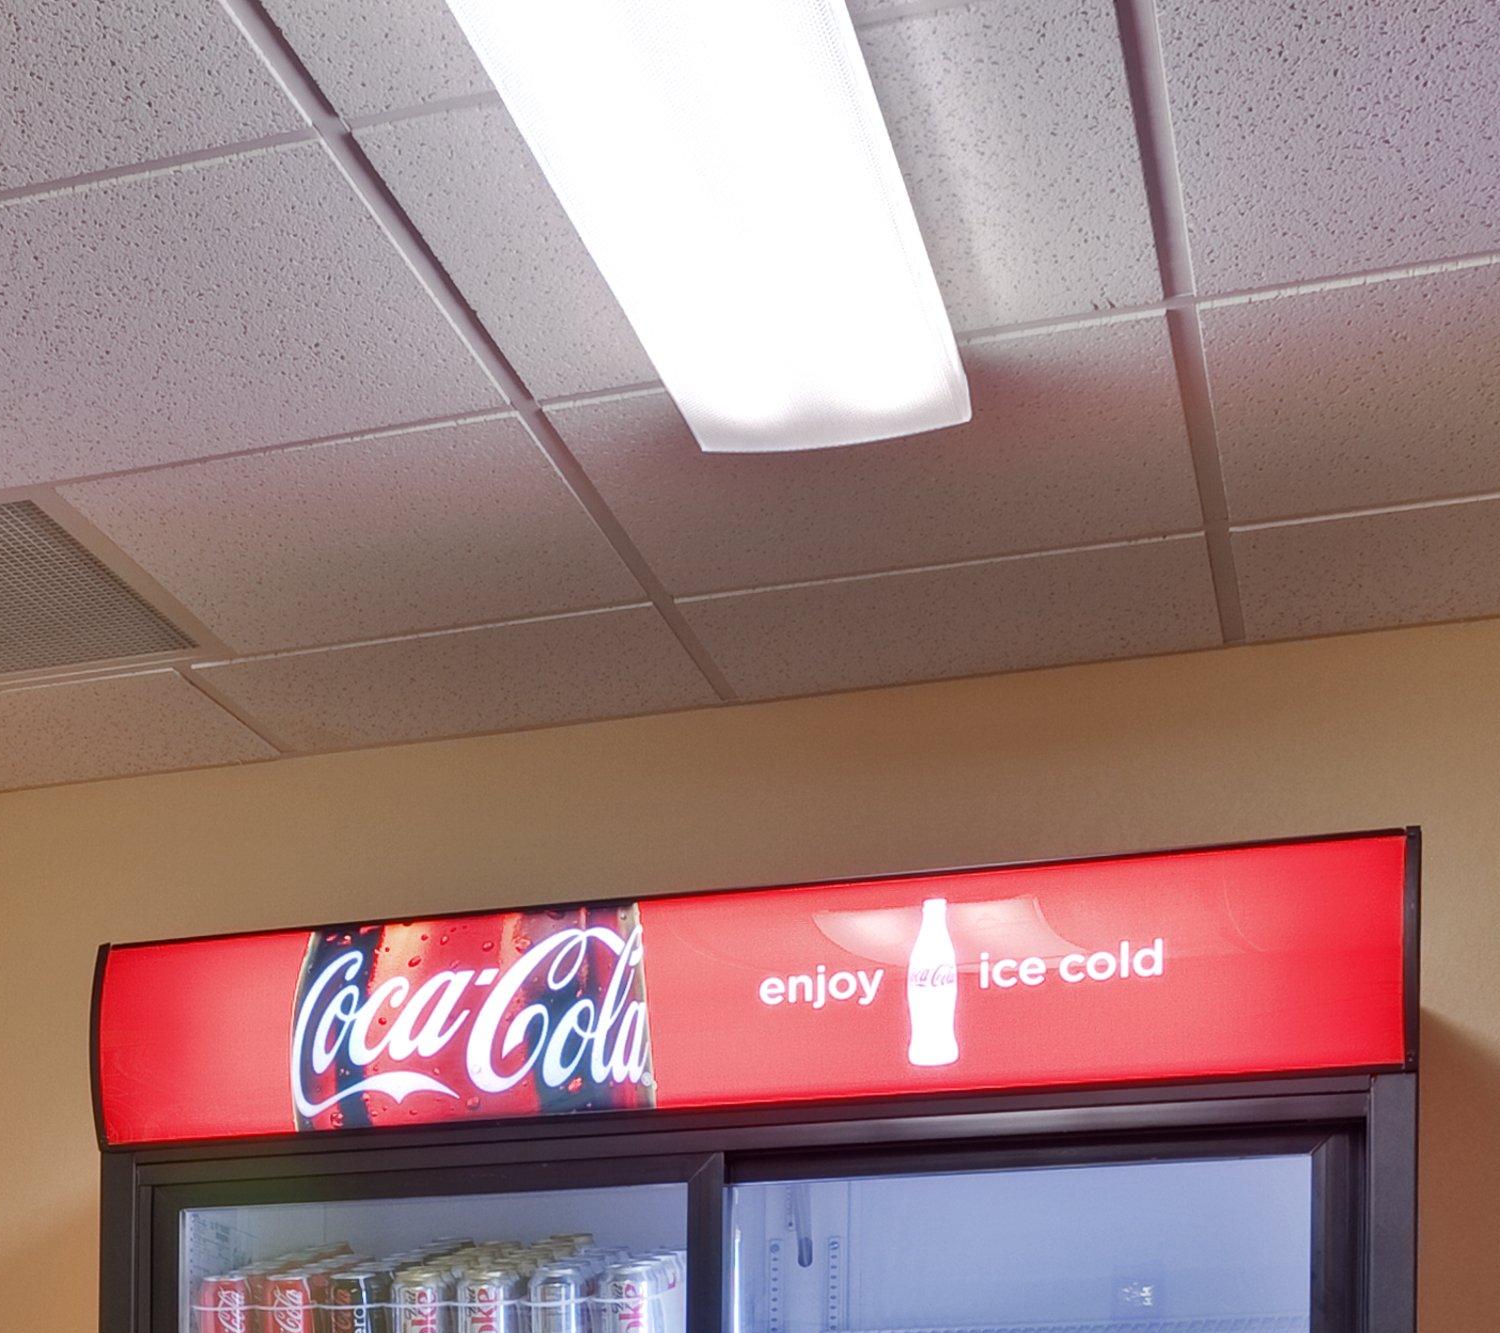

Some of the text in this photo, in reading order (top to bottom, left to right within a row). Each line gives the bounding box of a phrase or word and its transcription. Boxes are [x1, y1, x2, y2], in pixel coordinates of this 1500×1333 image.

[291, 925, 652, 1118] Coca-Cola
[759, 940, 1163, 1008] enjoy ice cold
